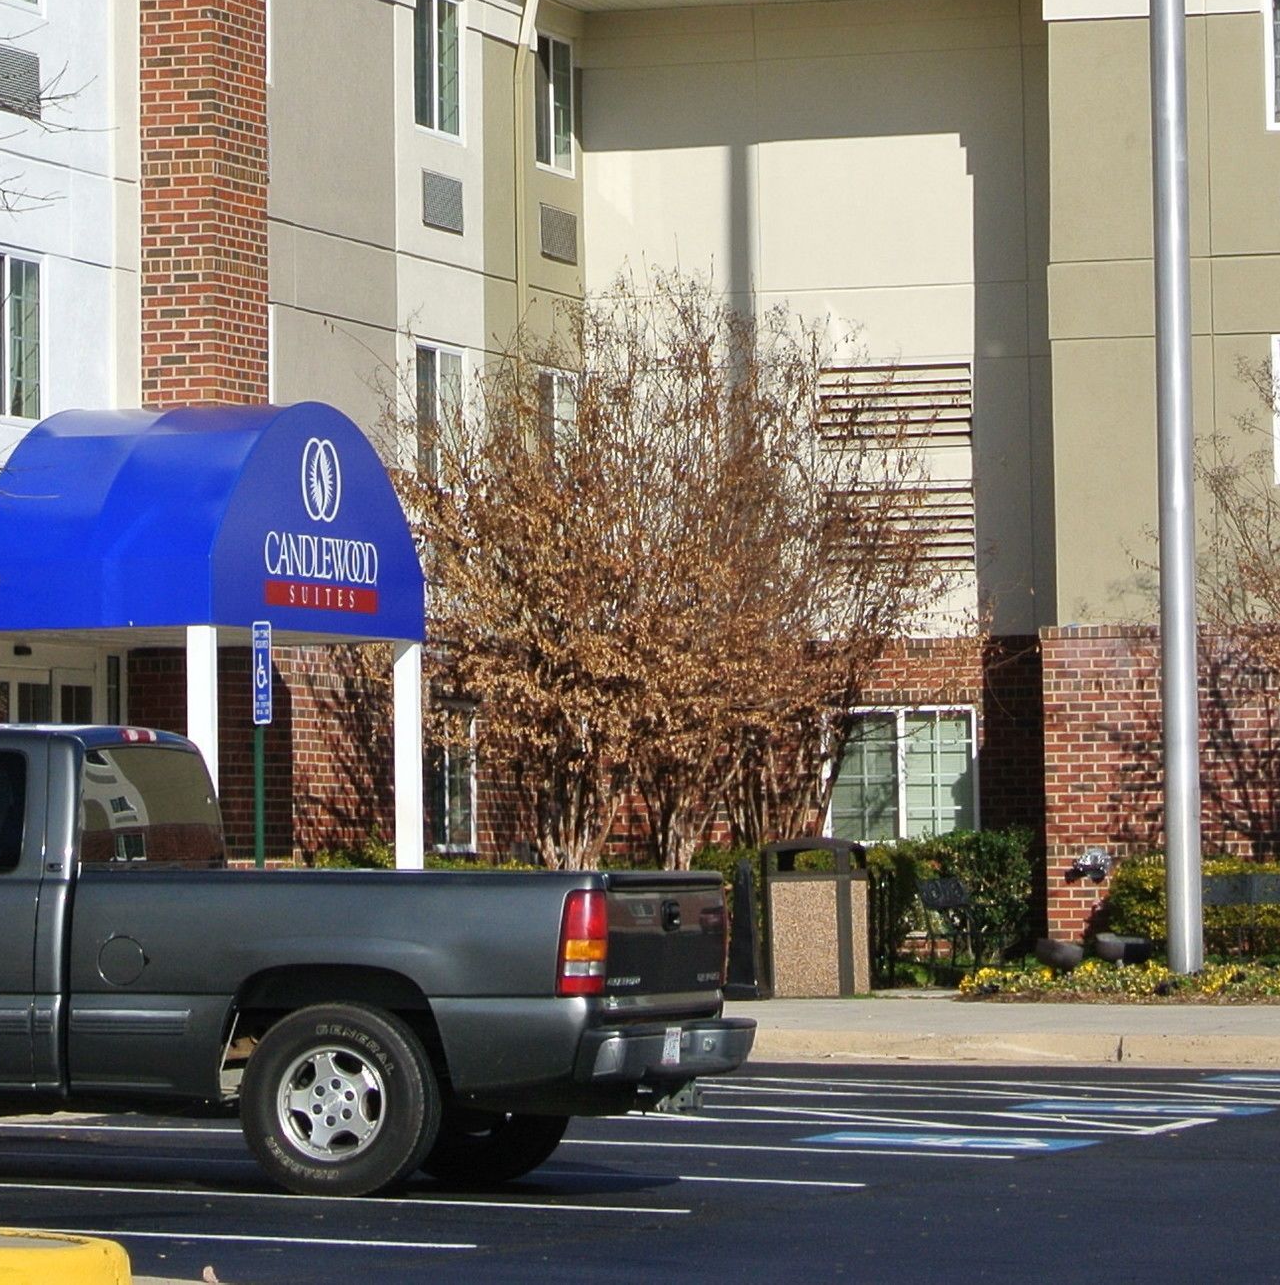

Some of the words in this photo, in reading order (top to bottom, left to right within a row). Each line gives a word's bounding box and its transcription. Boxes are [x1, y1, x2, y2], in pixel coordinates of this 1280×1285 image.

[265, 531, 378, 584] CANDLEWOOD
[289, 585, 356, 608] SUITES
[315, 1024, 395, 1076] GENERAL
